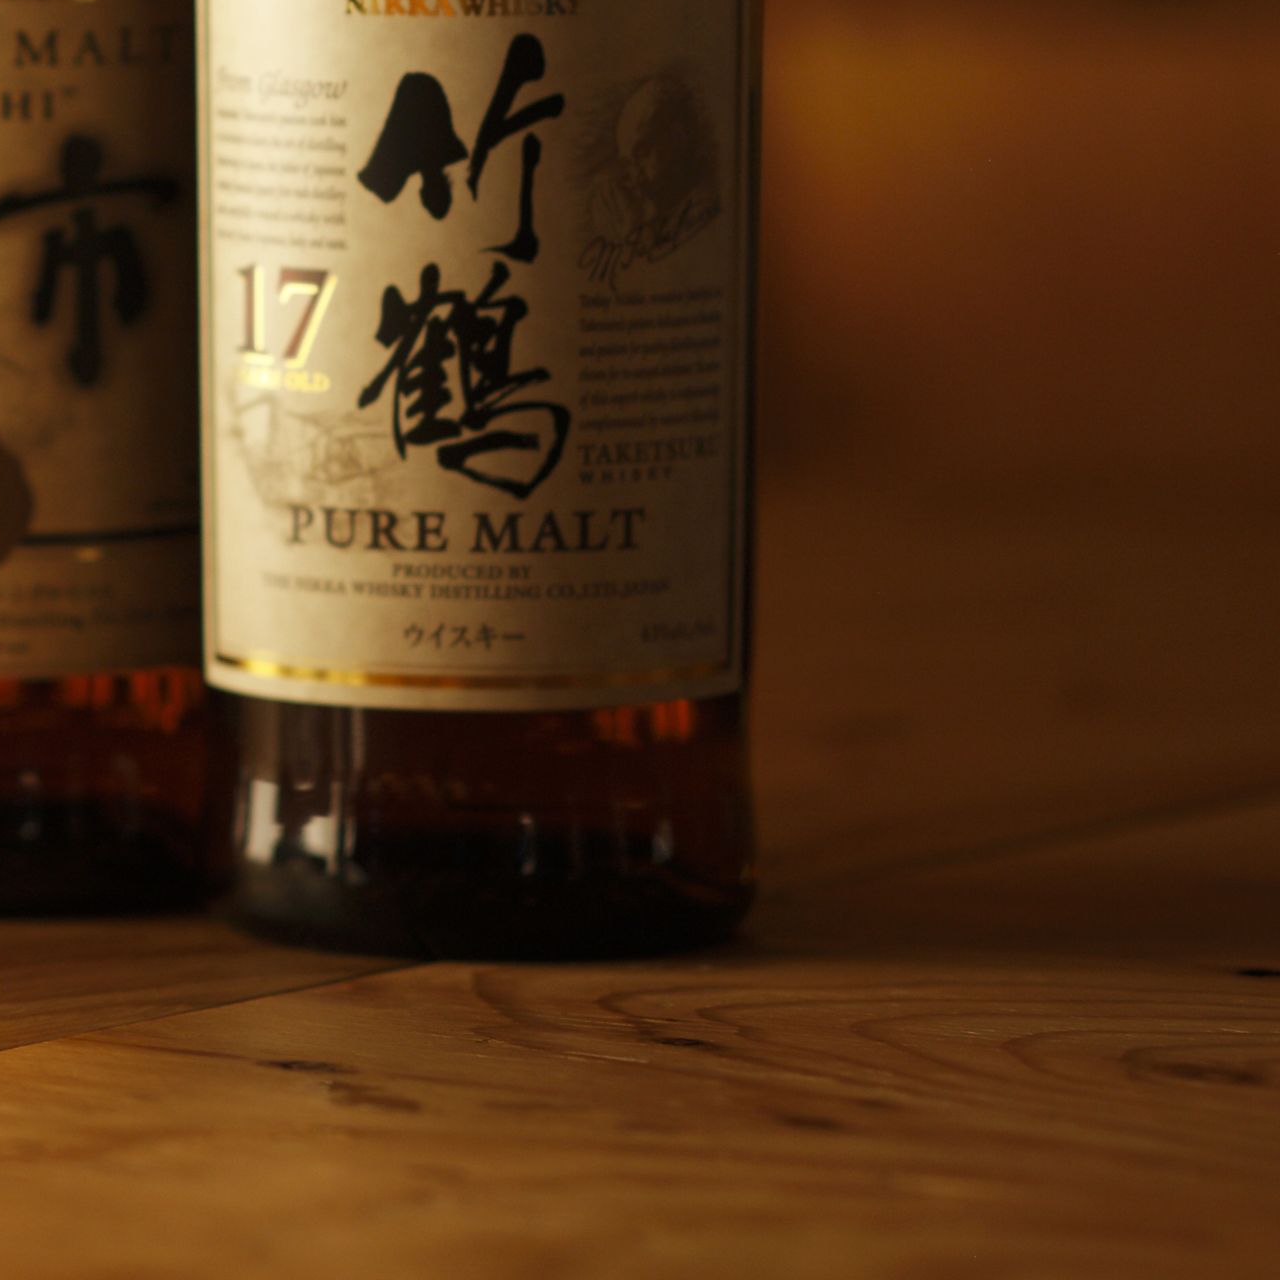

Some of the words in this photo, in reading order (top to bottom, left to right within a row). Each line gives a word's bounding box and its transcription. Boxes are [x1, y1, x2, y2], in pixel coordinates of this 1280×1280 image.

[13, 25, 182, 68] MALT
[356, 32, 571, 500] 竹鶴
[236, 262, 338, 370] 17
[286, 504, 449, 553] PURE
[469, 505, 648, 554] MALT
[353, 580, 424, 598] WHISKY
[429, 582, 542, 601] DISTILLING
[391, 562, 504, 581] PRODUCED
[507, 563, 533, 581] BY
[402, 622, 526, 650] ウイスキー
